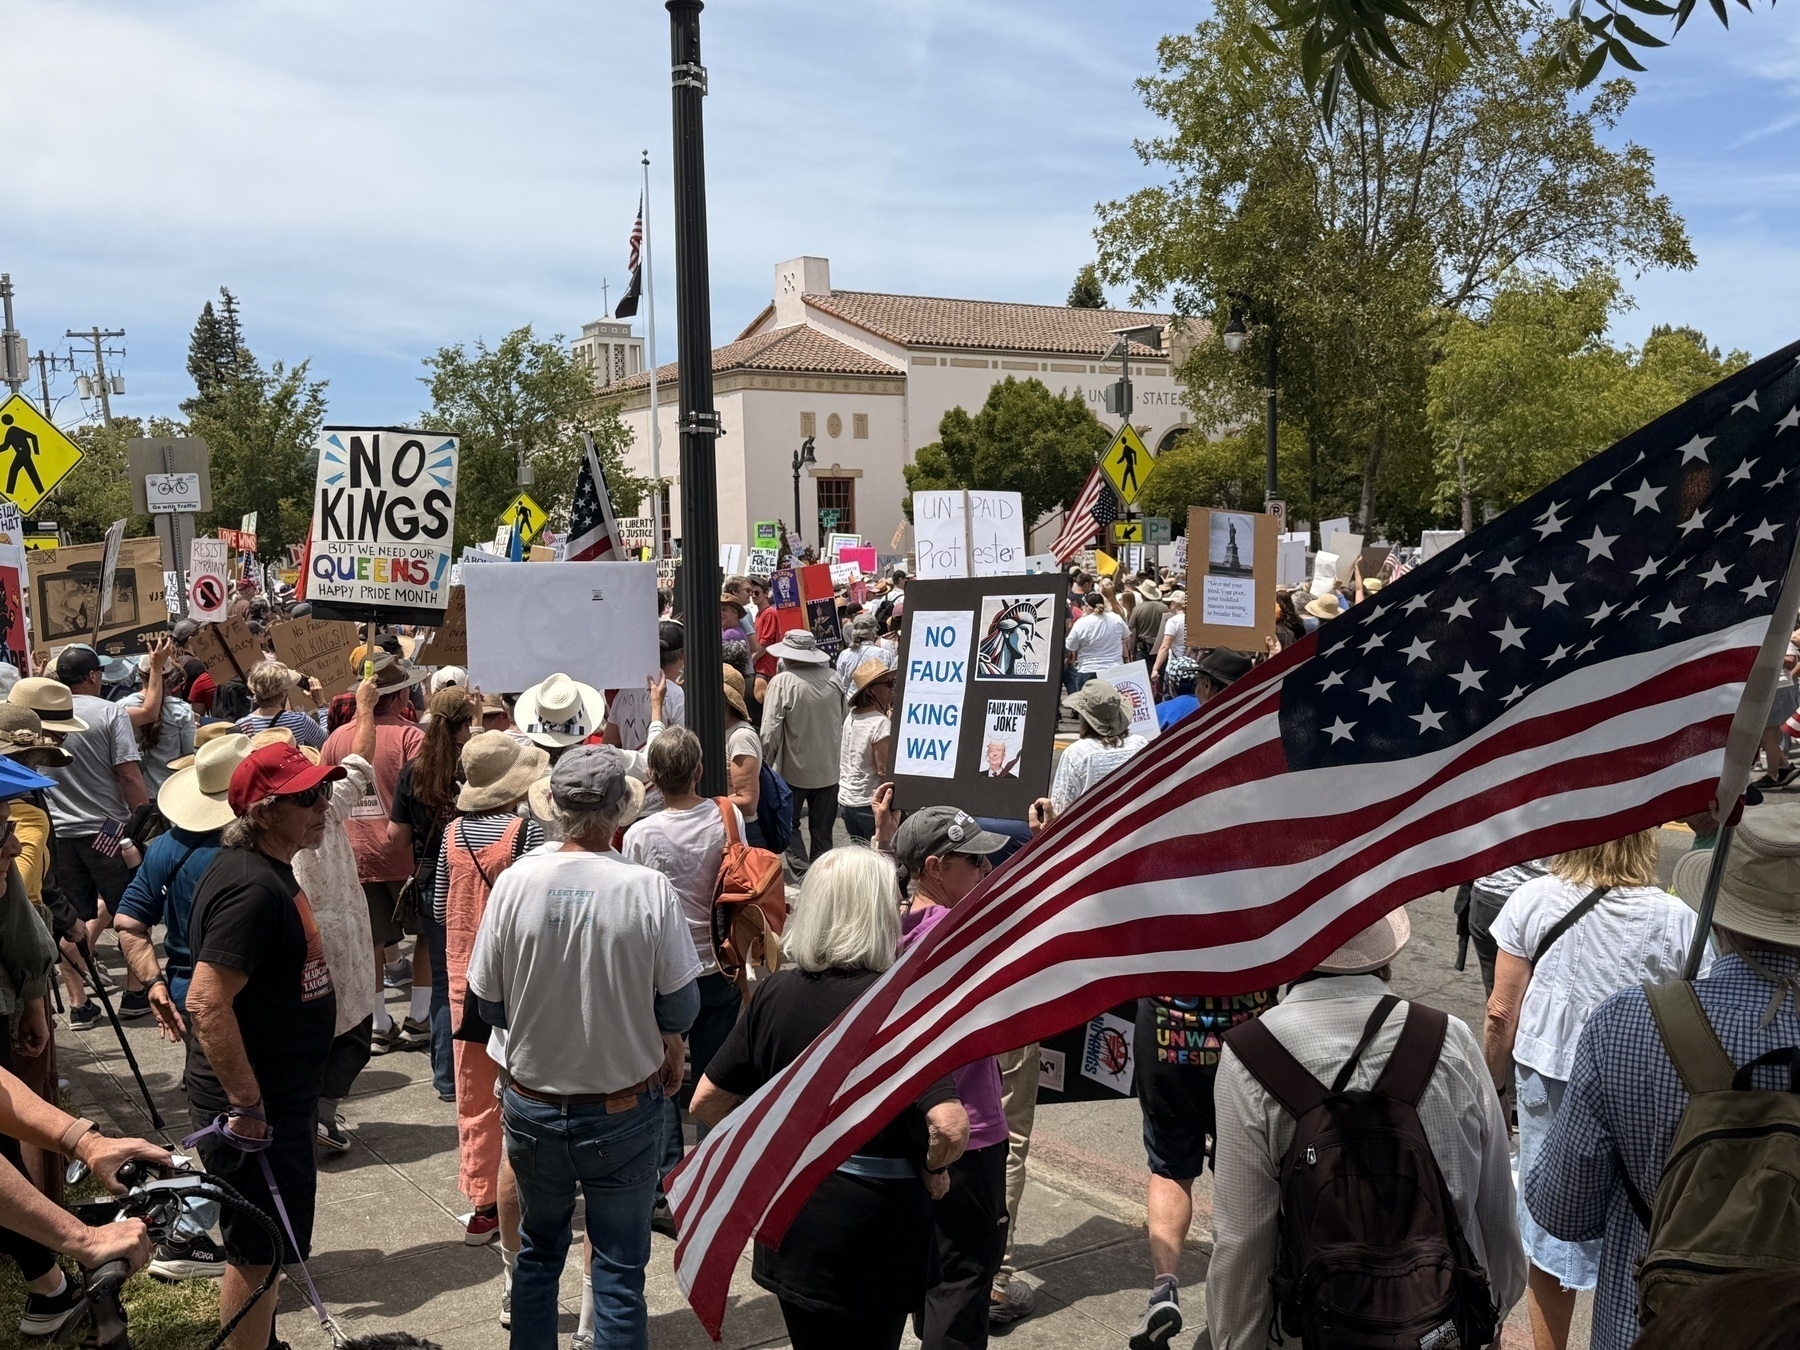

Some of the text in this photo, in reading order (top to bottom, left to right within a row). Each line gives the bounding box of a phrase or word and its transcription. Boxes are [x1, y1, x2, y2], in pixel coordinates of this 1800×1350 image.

[350, 434, 426, 488] NO
[322, 488, 452, 542] KINGS
[626, 519, 654, 528] LIBERTY
[219, 530, 256, 552] LOVE WINS
[626, 529, 654, 538] JUSTICE
[194, 542, 225, 558] RESIST
[328, 543, 434, 560] BUT WE NEED OUR
[634, 539, 647, 548] ALL
[192, 559, 226, 575] TYRANNY
[656, 560, 669, 568] ITH
[752, 555, 776, 566] FORCE
[312, 553, 450, 590] QUEENS!
[661, 579, 673, 588] FO
[318, 584, 354, 599] HAPPY
[360, 586, 391, 600] PRIDE
[395, 588, 438, 604] MONTH
[925, 626, 956, 648] NO
[291, 643, 306, 664] NO
[910, 660, 964, 683] FAUX
[907, 704, 958, 727] KING
[988, 701, 1027, 716] FAUX-KING
[1133, 707, 1149, 716] RACY
[994, 716, 1017, 732] JOKE
[907, 737, 952, 761] WAY
[355, 799, 378, 807] ARBOUR
[1156, 1005, 1268, 1027] PREVENT
[1156, 1029, 1221, 1048] UNWA
[1085, 1034, 1101, 1075] KINGS
[1157, 1048, 1221, 1065] PRESID
[191, 1250, 214, 1261] HOKA
